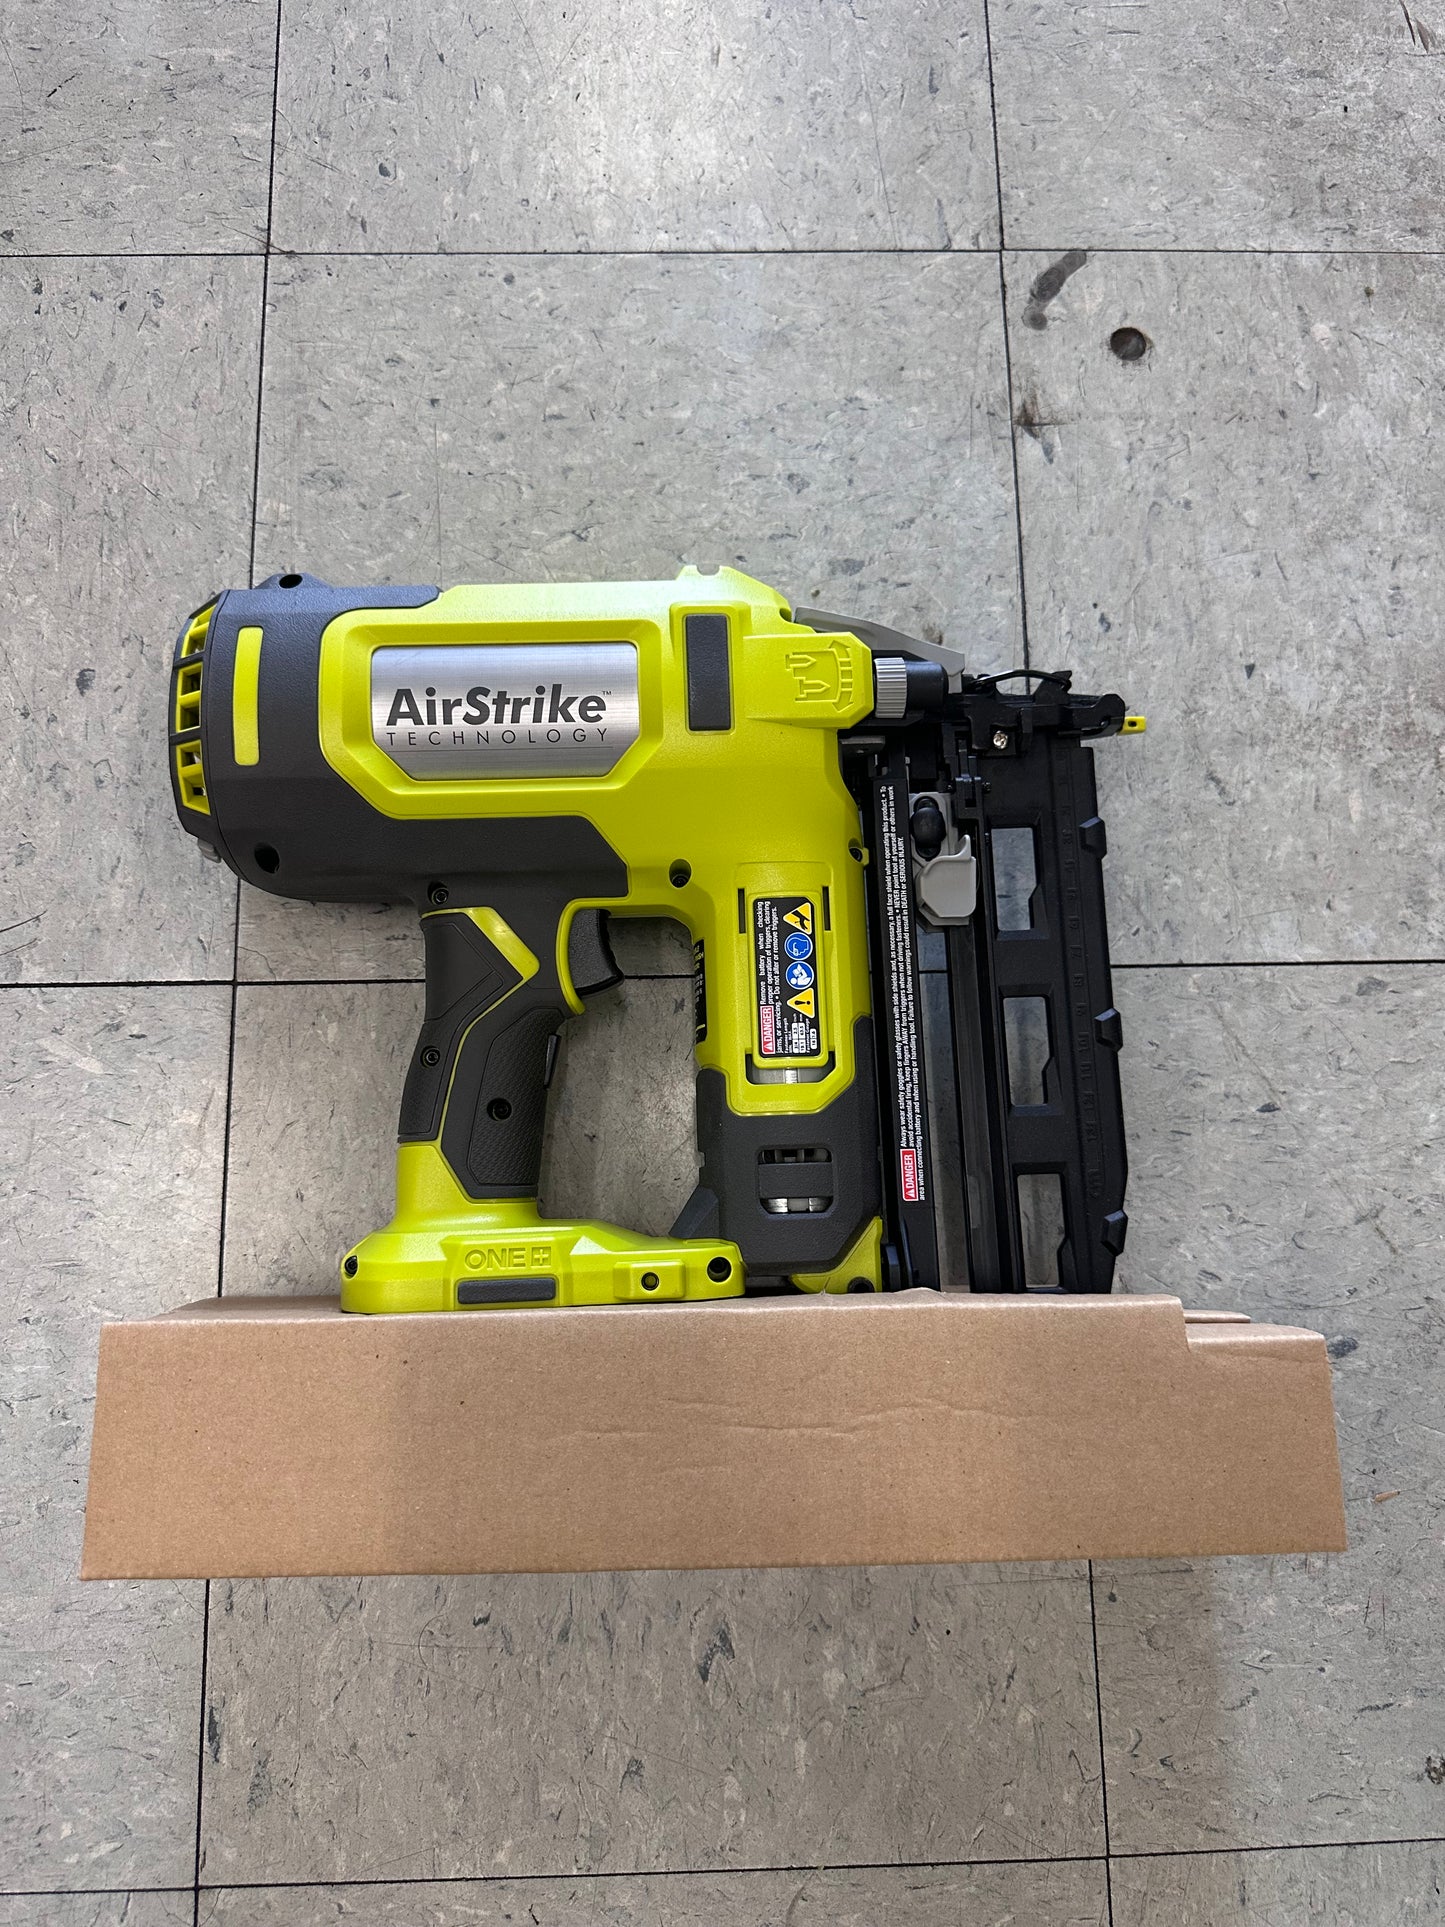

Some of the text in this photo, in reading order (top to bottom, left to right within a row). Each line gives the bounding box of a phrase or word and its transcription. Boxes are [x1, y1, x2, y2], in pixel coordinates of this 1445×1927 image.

[386, 727, 607, 746] TECHNOLOGY
[883, 833, 891, 859] operating
[890, 833, 898, 855] yourself
[897, 837, 905, 858] INJURY.
[898, 858, 906, 883] SERIOUS
[892, 874, 900, 889] point
[893, 890, 901, 909] NEVER
[900, 890, 908, 909] DEATH
[756, 901, 764, 928] checking
[763, 901, 771, 924] clearing
[764, 924, 772, 949] triggers,
[888, 921, 896, 950] necessary,
[896, 942, 904, 962] driving
[904, 949, 912, 975] warnings
[758, 955, 766, 976] battery
[765, 957, 774, 984] operation
[773, 986, 780, 995] Do
[898, 973, 906, 989] when
[899, 990, 907, 1012] triggers
[907, 1002, 915, 1021] Failure
[763, 1008, 773, 1042] DANGER
[894, 1019, 902, 1041] glasses
[776, 1037, 784, 1054] jams,
[901, 1027, 909, 1045] AWAY
[895, 1042, 903, 1060] safety
[903, 1045, 911, 1066] fingers
[909, 1035, 917, 1060] handling
[896, 1068, 905, 1090] goggles
[904, 1066, 912, 1081] keep
[911, 1068, 919, 1084] using
[897, 1091, 906, 1109] safety
[914, 1114, 922, 1135] battery
[900, 1126, 908, 1148] Always
[907, 1131, 915, 1148] avoid
[915, 1136, 924, 1168] connecting
[904, 1154, 915, 1189] DANGER
